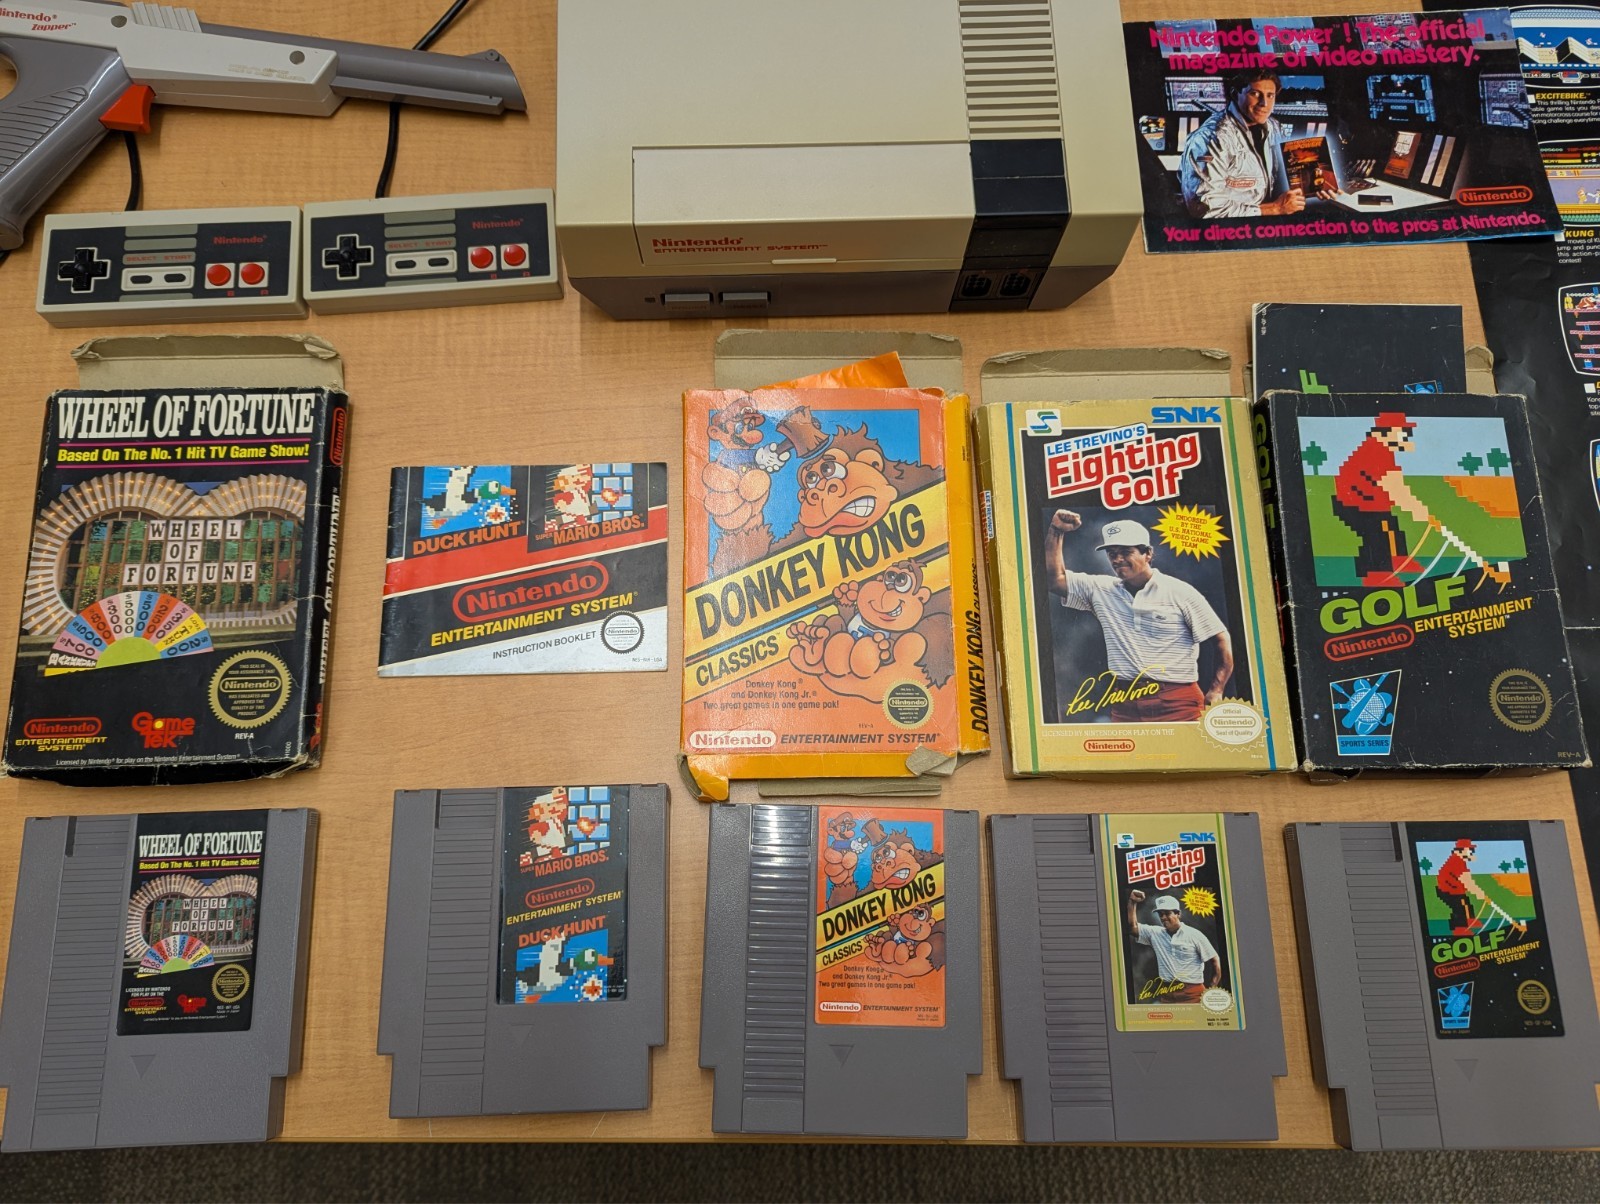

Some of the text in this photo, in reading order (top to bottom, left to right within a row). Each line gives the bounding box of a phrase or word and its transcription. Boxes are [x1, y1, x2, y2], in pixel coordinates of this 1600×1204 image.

[32, 23, 71, 31] Zapper
[1150, 24, 1260, 48] Nintendo
[1264, 24, 1333, 45] Power
[1357, 22, 1399, 42] The
[1404, 18, 1486, 41] official
[1169, 45, 1480, 74] magazine of video mastery.
[1462, 190, 1523, 203] Nintendo
[472, 220, 521, 230] Nintendo
[1163, 211, 1547, 242] Your direct connection to the pros at Nintendo.
[213, 236, 263, 245] Nintendo
[652, 237, 742, 247] Nintendo
[654, 246, 761, 254] ENTERTAINMENT
[58, 393, 315, 439] WHEEL OF FORTUNE
[1151, 406, 1222, 424] SNK
[333, 412, 345, 461] Nintendo
[1047, 425, 1146, 456] LEE TREVINO'S
[57, 444, 309, 462] Based On The No. 1 Hit TV Game Show!
[1048, 435, 1198, 489] Fighting
[1254, 413, 1276, 529] GOLF
[1103, 467, 1181, 508] Golf
[1176, 514, 1208, 525] ENDORSED
[150, 522, 239, 538] WHEEL
[413, 523, 520, 555] DUCK HUNT
[535, 517, 645, 545] SUPER MARIO BROS.
[1182, 528, 1213, 538] NATIONAL
[1182, 541, 1198, 549] TEAM
[1191, 536, 1209, 545] GAME
[169, 543, 198, 559] OF
[126, 564, 252, 582] FORTUNE
[695, 543, 826, 639] DONKEY
[834, 503, 926, 578] KONG
[466, 573, 597, 613] Nintendo
[1319, 575, 1467, 634] GOLF
[431, 592, 633, 647] ENTERTAINMENT SYSTEM
[1414, 597, 1533, 633] ENTERTAINMENT
[1449, 615, 1506, 638] SYSTEM
[493, 641, 552, 660] INSTRUCTION
[554, 631, 597, 647] BOOKLET
[1332, 631, 1408, 656] Nintendo
[696, 635, 780, 686] CLASSICS
[224, 680, 276, 690] Nintendo
[746, 680, 797, 690] Donkey Kong
[731, 690, 812, 700] and Donkey Kong Jr.
[1066, 677, 1096, 716] Lee
[1500, 694, 1541, 702] Nintendo
[720, 702, 741, 711] great
[742, 703, 770, 711] games
[798, 703, 822, 711] game
[823, 700, 840, 710] pak!
[30, 722, 96, 734] Nintendo
[132, 712, 196, 734] Game
[15, 737, 107, 746] ENTERTAINMENT
[142, 732, 177, 748] Tek
[695, 733, 772, 746] Nintendo
[781, 733, 937, 744] ENTERTAINMENT SYSTEM
[1088, 741, 1132, 750] Nintendo
[1340, 739, 1389, 748] SPORTS SERIES
[56, 758, 82, 766] Licensed
[83, 759, 88, 767] by
[124, 757, 136, 765] play
[144, 755, 153, 763] the
[217, 753, 238, 761] System
[139, 831, 263, 857] WHEEL OF FORTUNE
[1180, 832, 1216, 842] SNK
[1127, 843, 1178, 860] LEE TREVINO'S
[520, 850, 610, 877] SUPER MARIO BROS.
[1127, 848, 1204, 877] Fighting
[1155, 866, 1195, 889] Golf
[531, 884, 590, 904] Nintendo
[184, 900, 226, 908] WHEEL
[506, 891, 621, 925] ENTERTAINMENT SYSTEM
[822, 873, 936, 942] DONKEY KONG
[193, 910, 206, 919] OF
[173, 921, 232, 932] FORTUNE
[519, 915, 606, 947] DUCK HUNT
[822, 941, 863, 966] CLASSICS
[1431, 930, 1506, 963] GOLF
[1479, 941, 1540, 962] ENTERTAINMENT
[1438, 961, 1477, 975] Nintendo
[1496, 953, 1527, 965] SYSTEM
[822, 1003, 859, 1011] Nintendo
